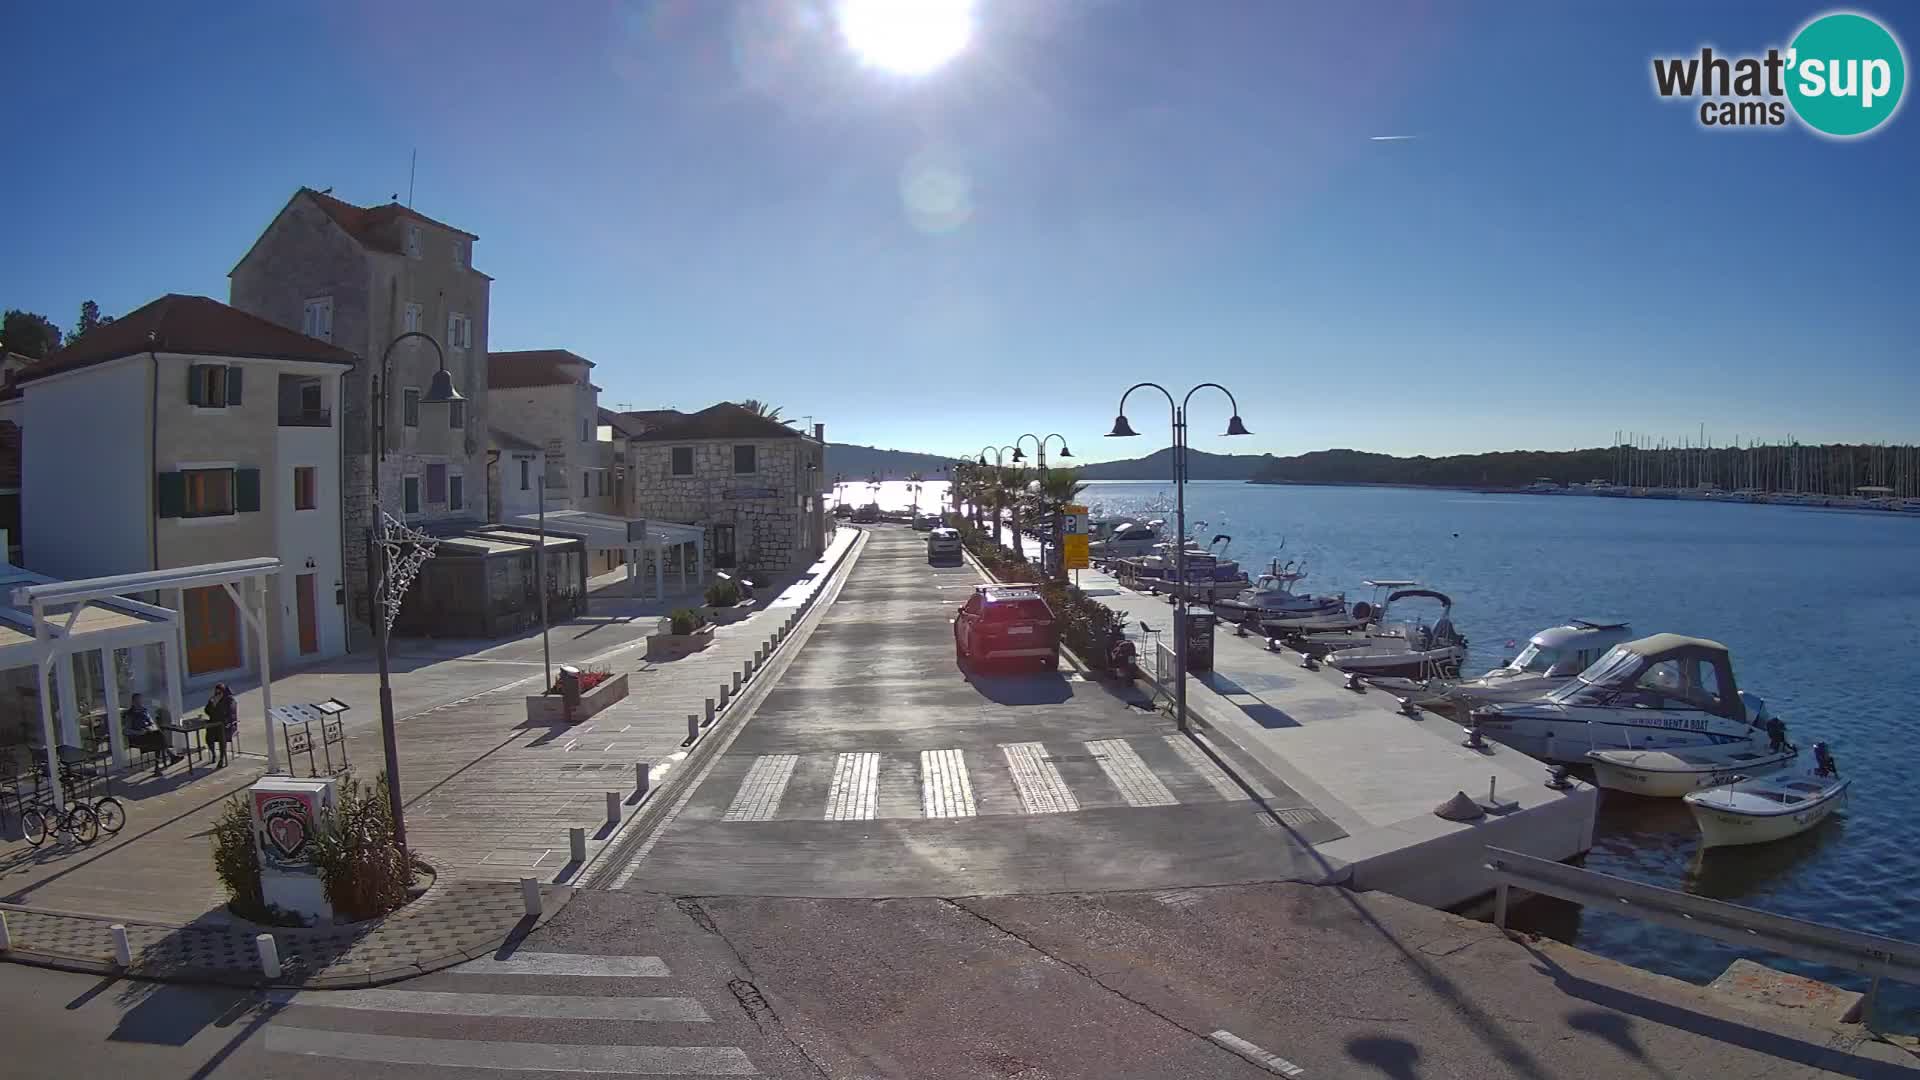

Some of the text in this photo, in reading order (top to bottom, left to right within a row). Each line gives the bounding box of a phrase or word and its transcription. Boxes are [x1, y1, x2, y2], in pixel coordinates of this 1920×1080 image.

[1064, 515, 1076, 531] P
[1664, 719, 1683, 728] RENT
[1690, 719, 1709, 731] BOAT
